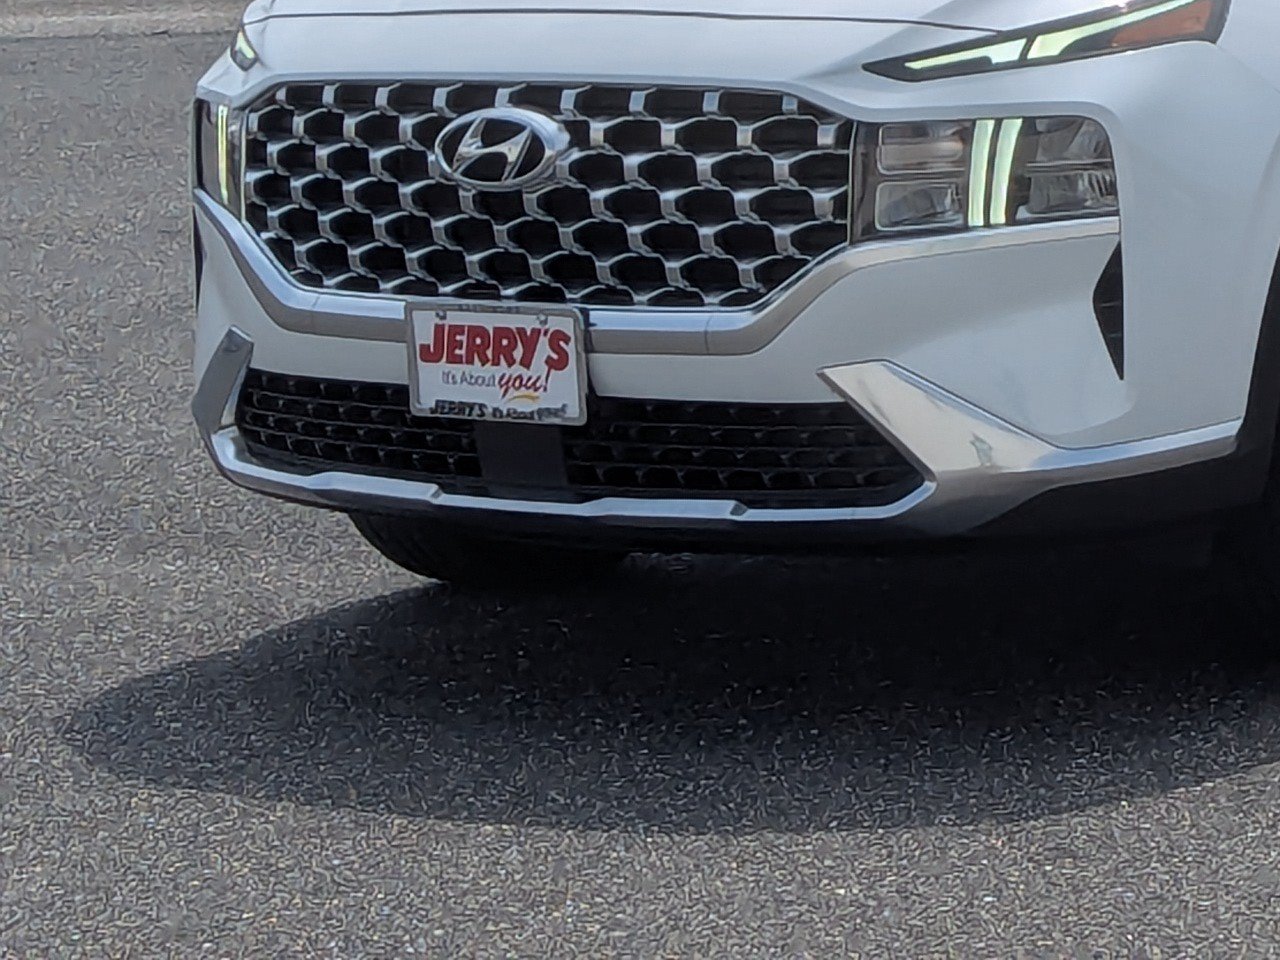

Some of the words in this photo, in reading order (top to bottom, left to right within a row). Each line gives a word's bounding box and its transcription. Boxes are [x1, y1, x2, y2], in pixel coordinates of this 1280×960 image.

[418, 323, 572, 371] JERRY'S
[442, 370, 458, 386] It's
[459, 371, 496, 388] About
[497, 367, 551, 400] you!
